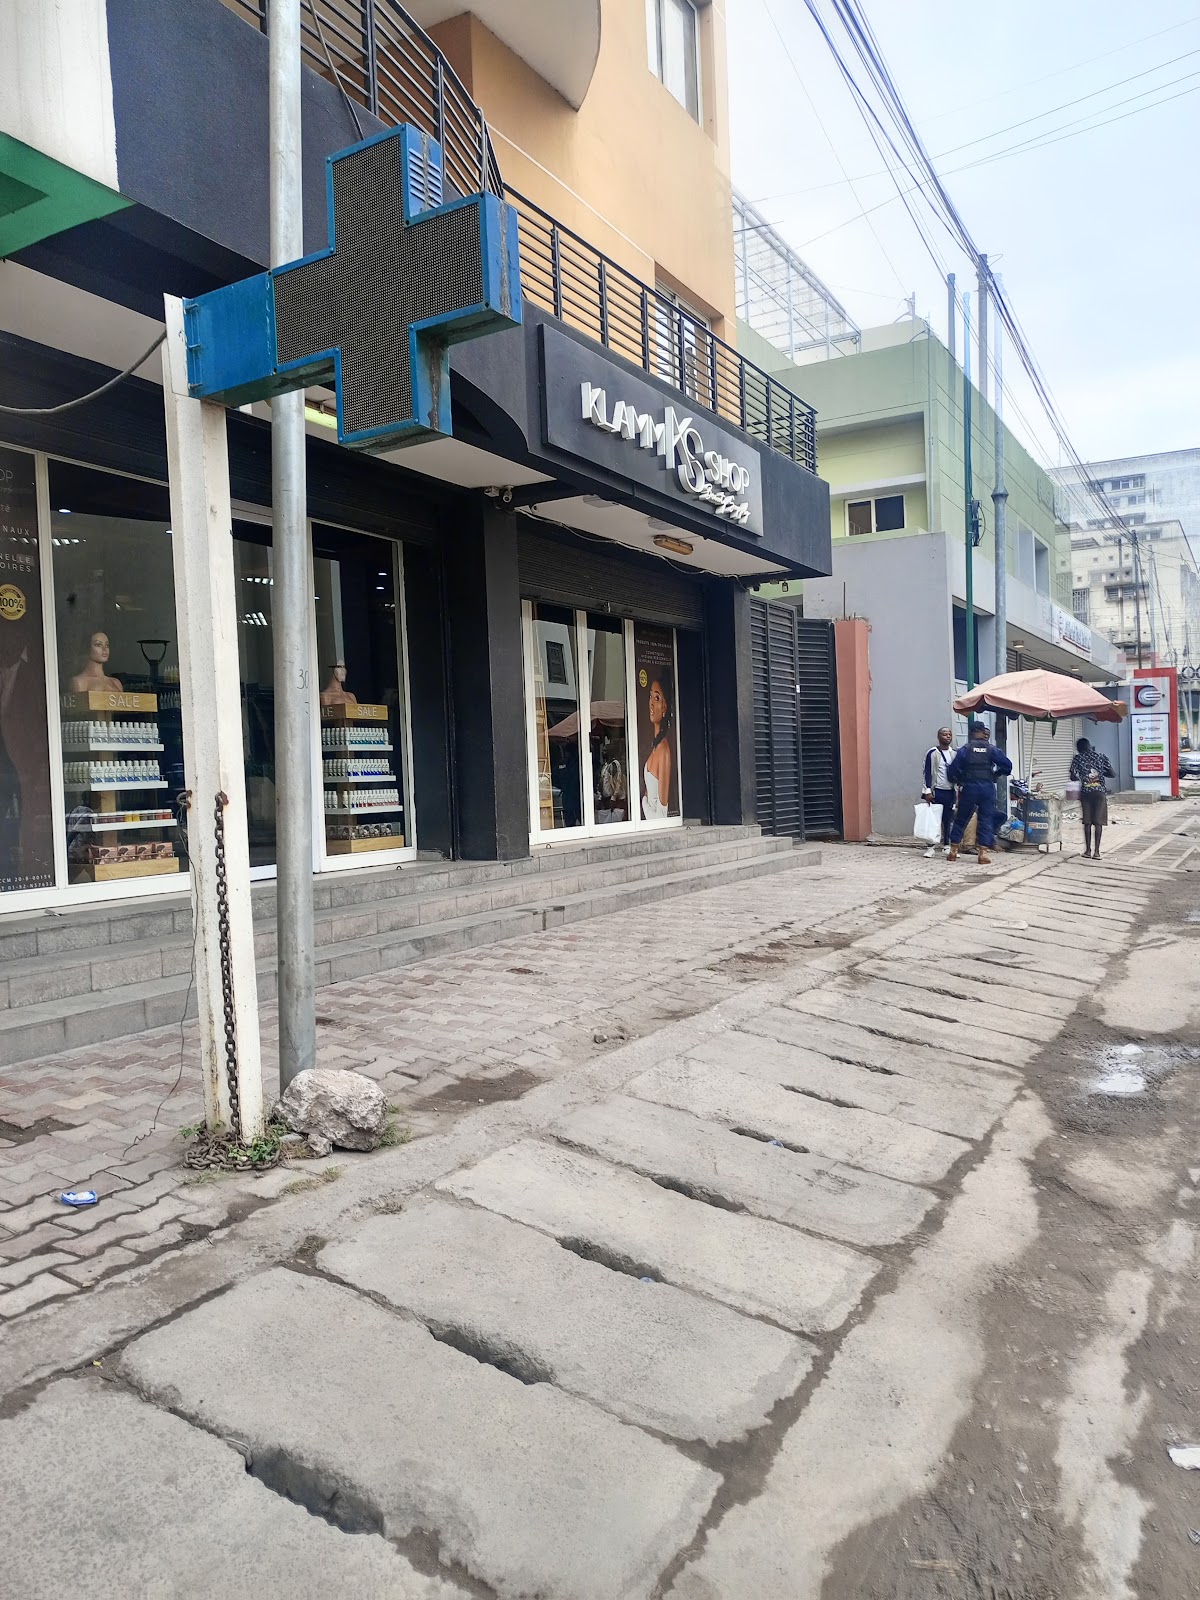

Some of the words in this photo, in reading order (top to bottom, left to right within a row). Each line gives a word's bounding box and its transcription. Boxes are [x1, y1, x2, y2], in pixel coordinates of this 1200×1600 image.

[704, 450, 750, 495] SHOP
[108, 694, 140, 708] SALE
[357, 706, 378, 718] SALE
